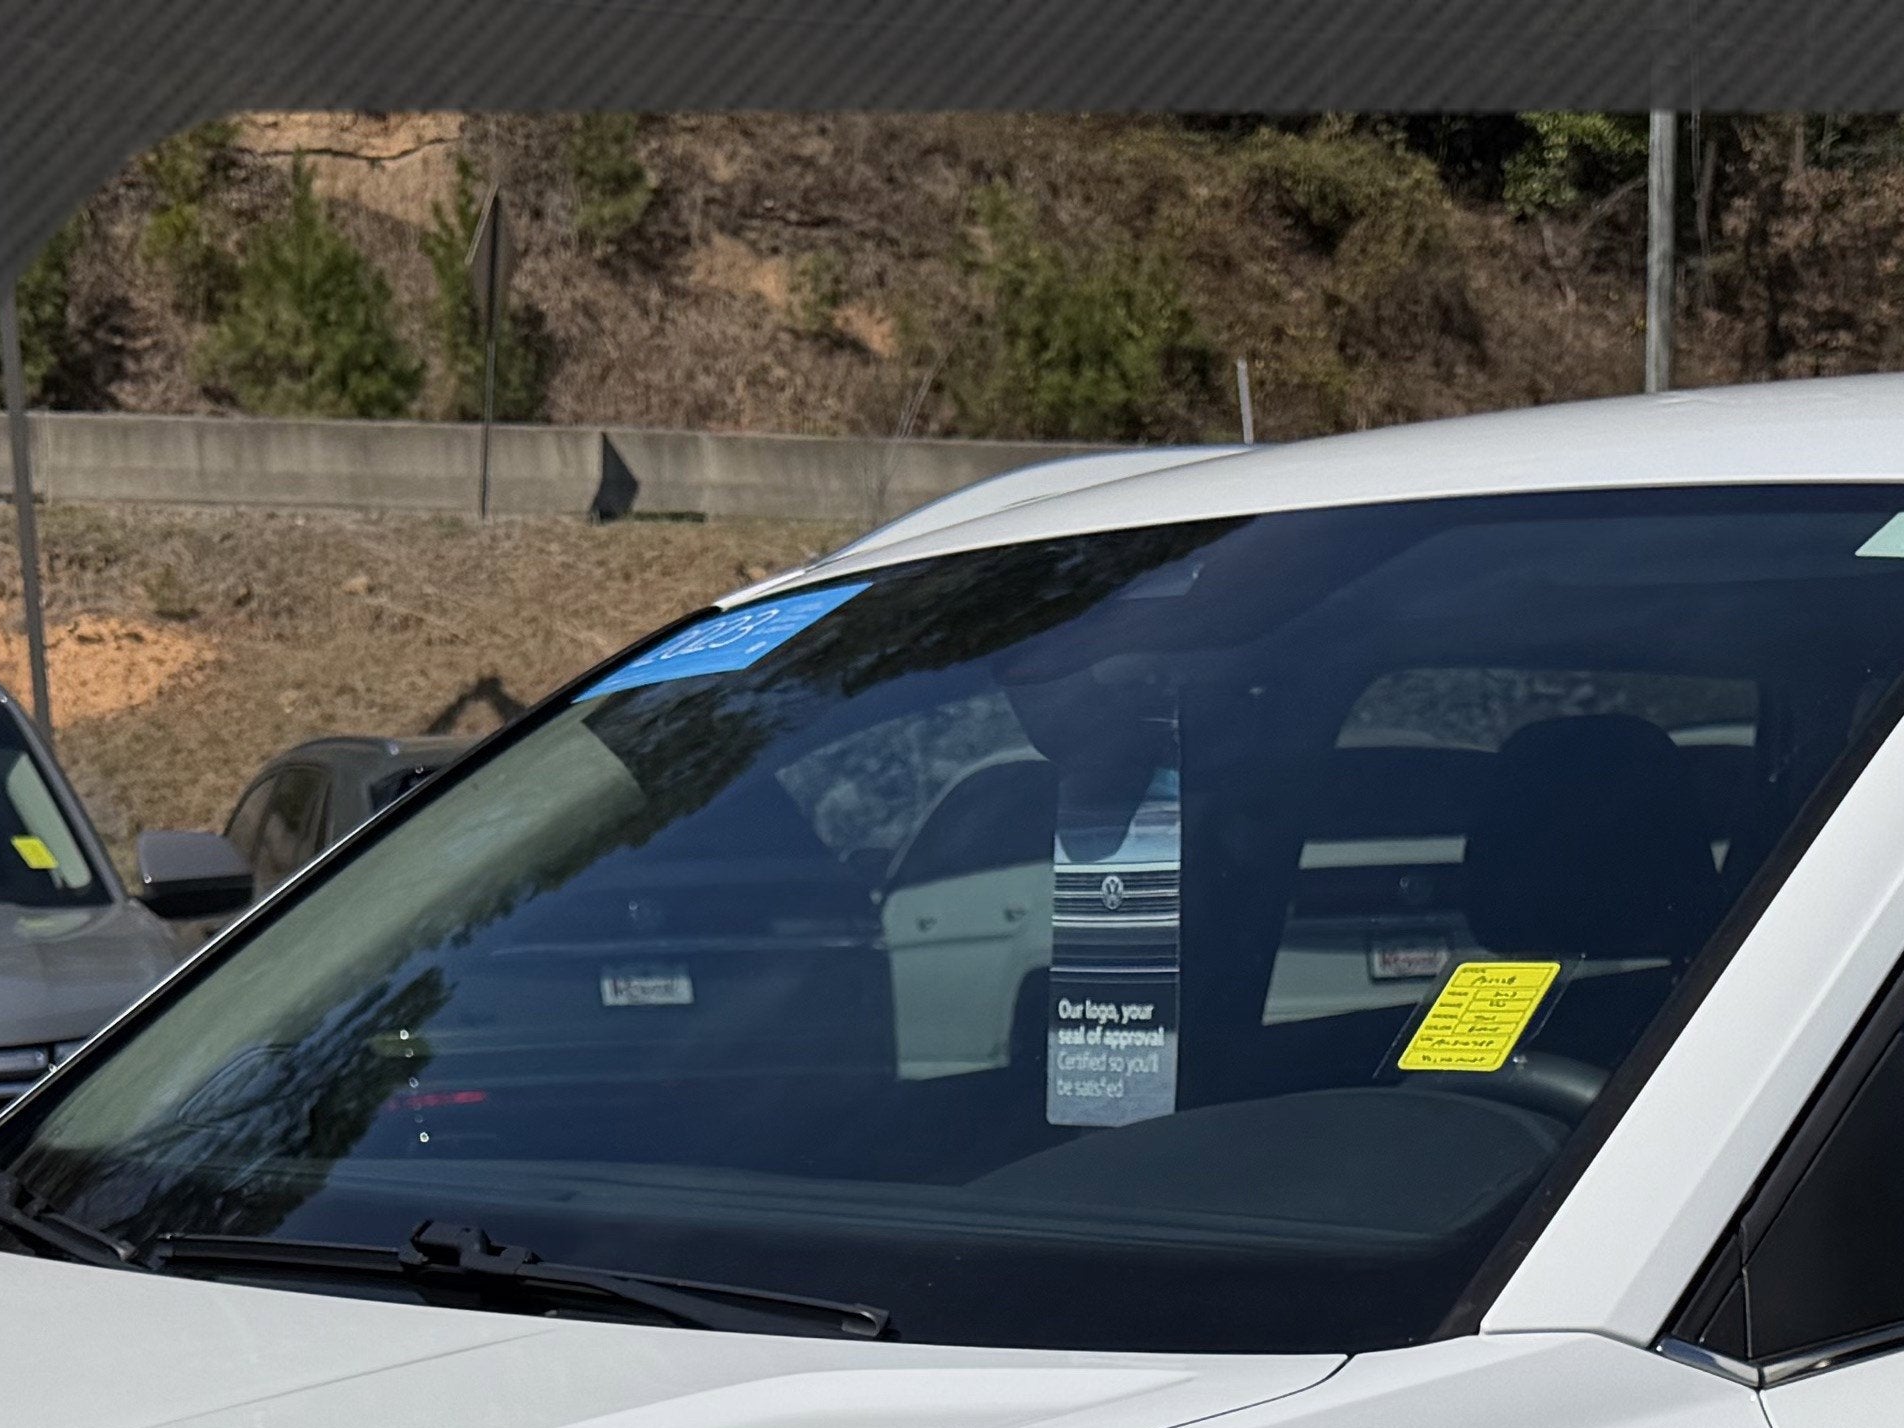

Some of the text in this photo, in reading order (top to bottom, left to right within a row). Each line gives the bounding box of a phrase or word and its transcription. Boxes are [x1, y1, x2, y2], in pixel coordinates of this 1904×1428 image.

[1058, 998, 1154, 1025] Our logo, your
[1058, 1025, 1165, 1050] seal of approval
